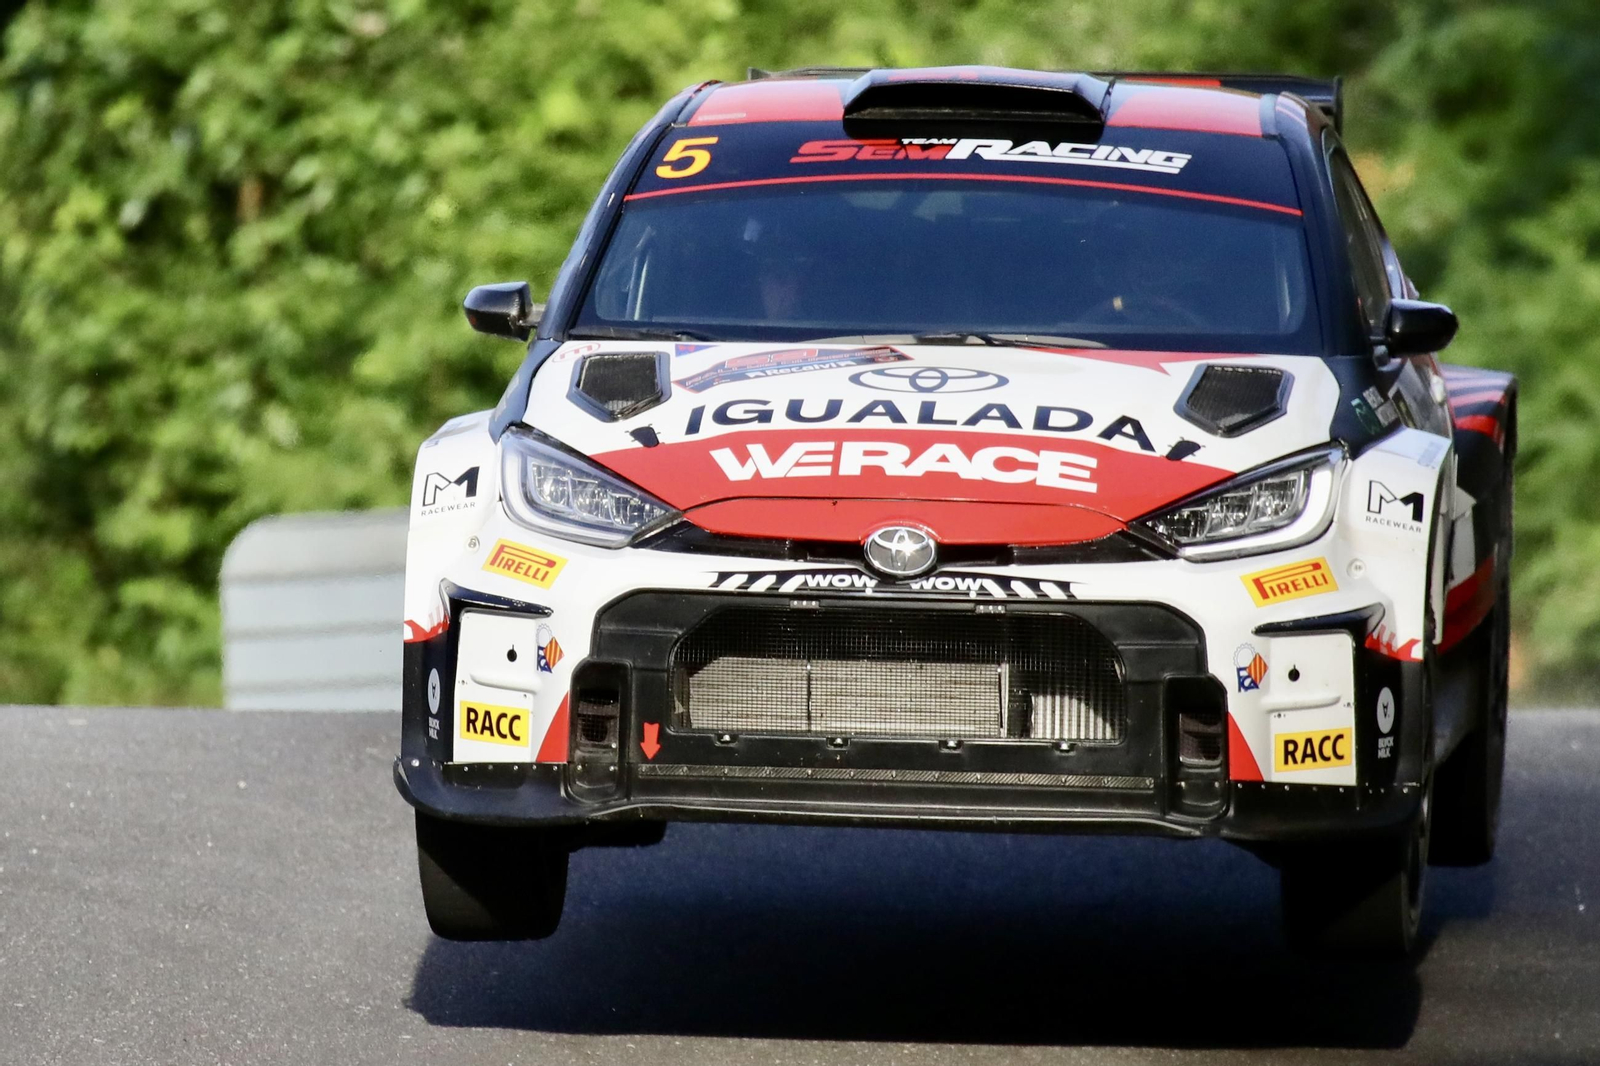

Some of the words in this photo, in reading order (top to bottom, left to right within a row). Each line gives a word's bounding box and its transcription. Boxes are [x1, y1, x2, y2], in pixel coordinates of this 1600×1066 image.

[655, 136, 719, 179] 5
[945, 138, 1192, 174] RACING
[765, 360, 837, 376] Recalvi
[685, 399, 1157, 453] IGUALADA
[708, 441, 1098, 493] WERACE
[421, 501, 476, 516] RACEWEAR
[1365, 515, 1422, 533] RACEWEAR
[489, 543, 557, 582] PIRELLI
[804, 574, 879, 588] WOW
[909, 577, 983, 591] WOW
[1252, 562, 1329, 600] PIRELLI
[465, 707, 521, 742] RACC
[1283, 733, 1345, 765] RACC
